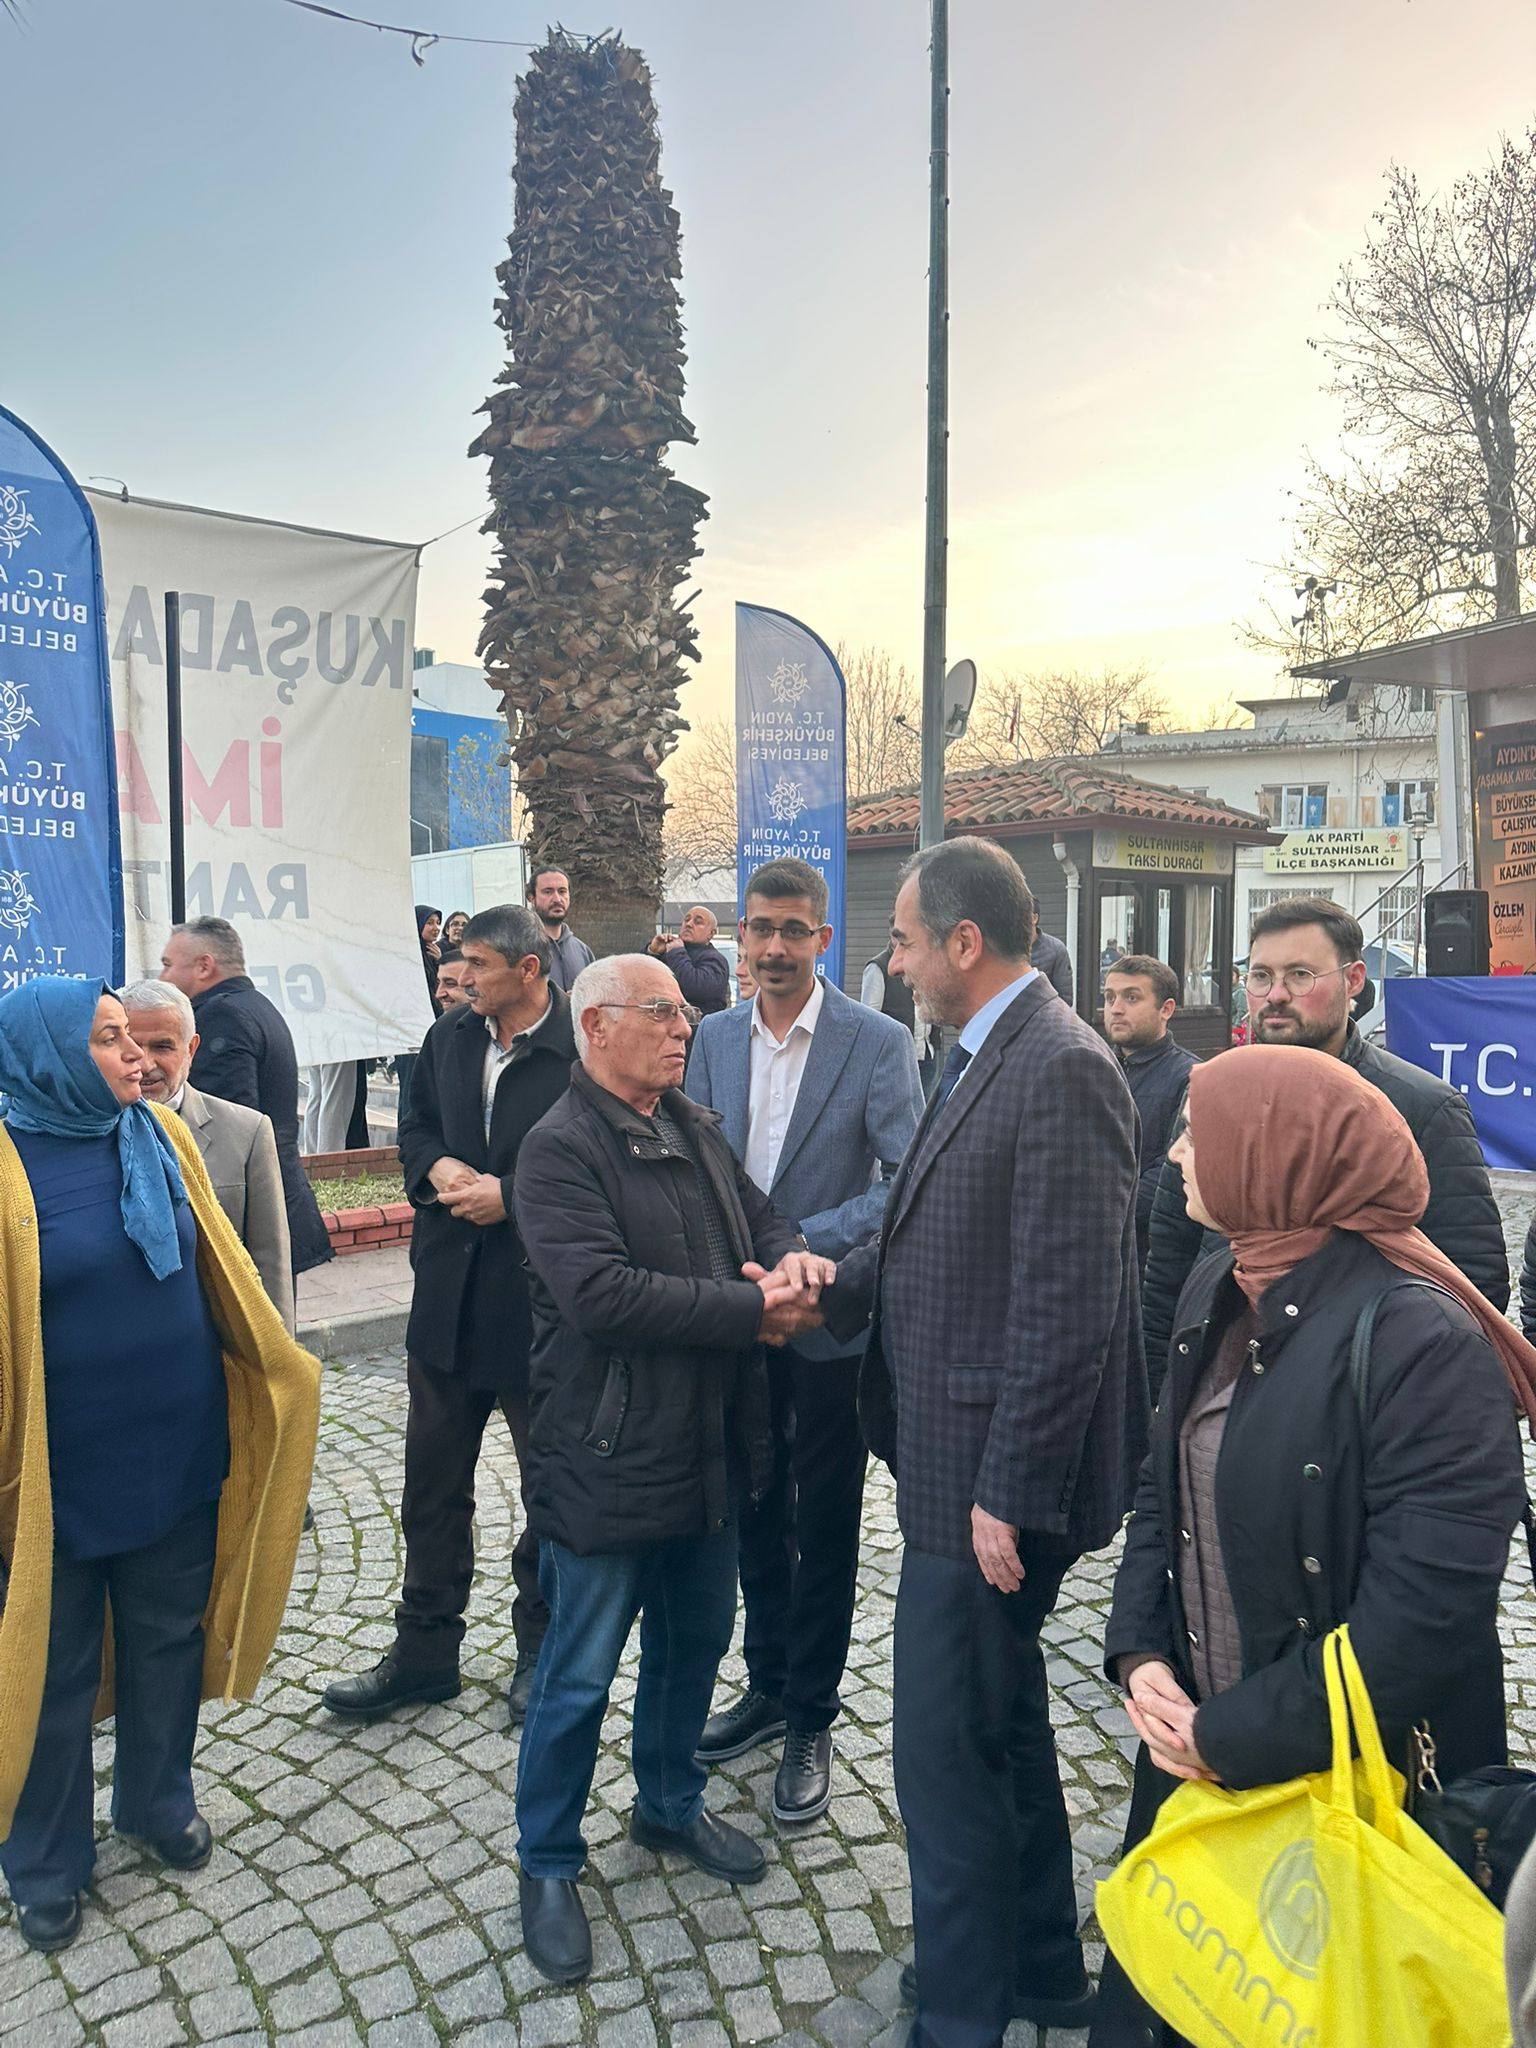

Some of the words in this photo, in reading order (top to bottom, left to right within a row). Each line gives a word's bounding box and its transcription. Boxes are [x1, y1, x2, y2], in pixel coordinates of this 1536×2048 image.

[1307, 833, 1324, 843] AK
[1328, 830, 1364, 842] PARTİ
[1292, 844, 1379, 856] SULTANHİSAR
[1127, 852, 1161, 868] TAKSİ
[1163, 855, 1203, 870] DURAĞI
[1276, 858, 1307, 869] İLÇE
[1311, 856, 1394, 869] BAŞKANLIĞI
[1493, 901, 1525, 919] ÖZLEM
[1430, 1042, 1532, 1096] T.C.
[1126, 1857, 1317, 2048] mamm
